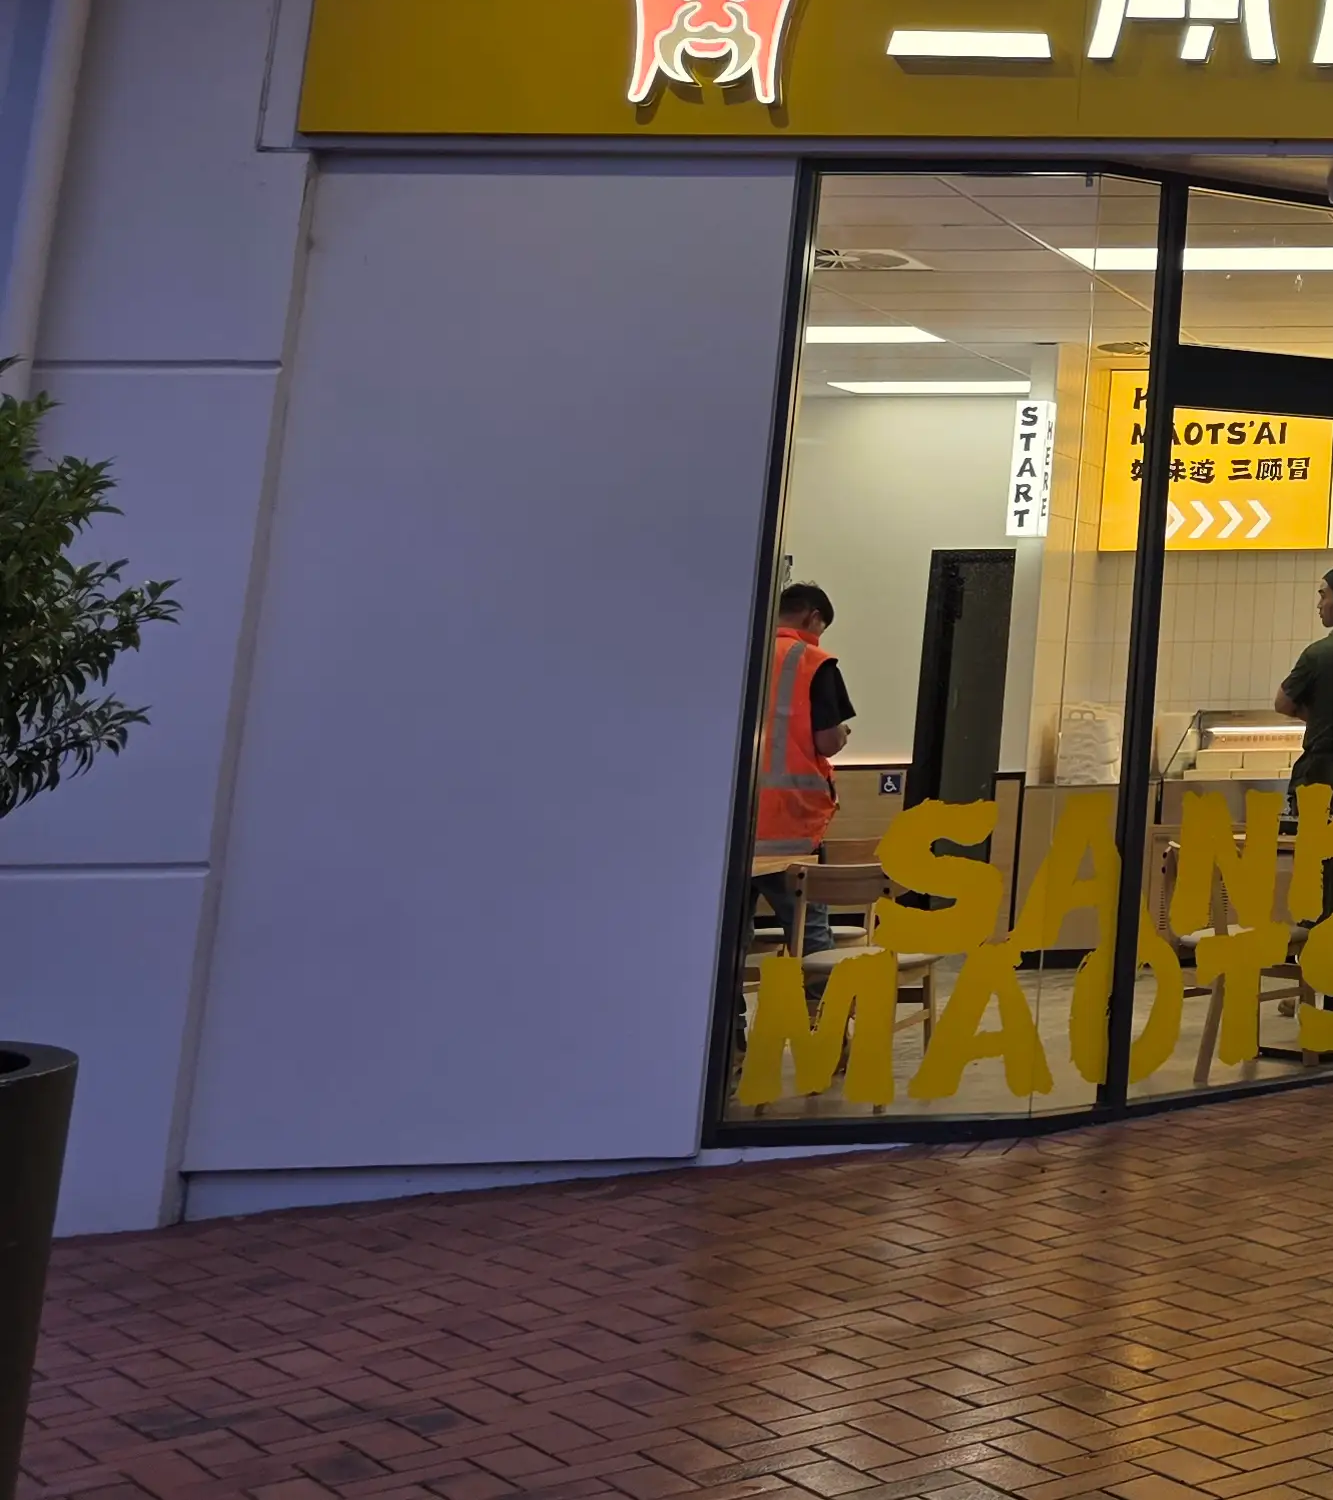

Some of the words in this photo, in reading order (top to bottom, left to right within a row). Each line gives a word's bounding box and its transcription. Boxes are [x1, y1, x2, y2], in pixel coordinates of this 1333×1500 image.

[1013, 406, 1038, 528] START
[1040, 421, 1054, 517] HERE
[1228, 457, 1311, 481] 三顾冒
